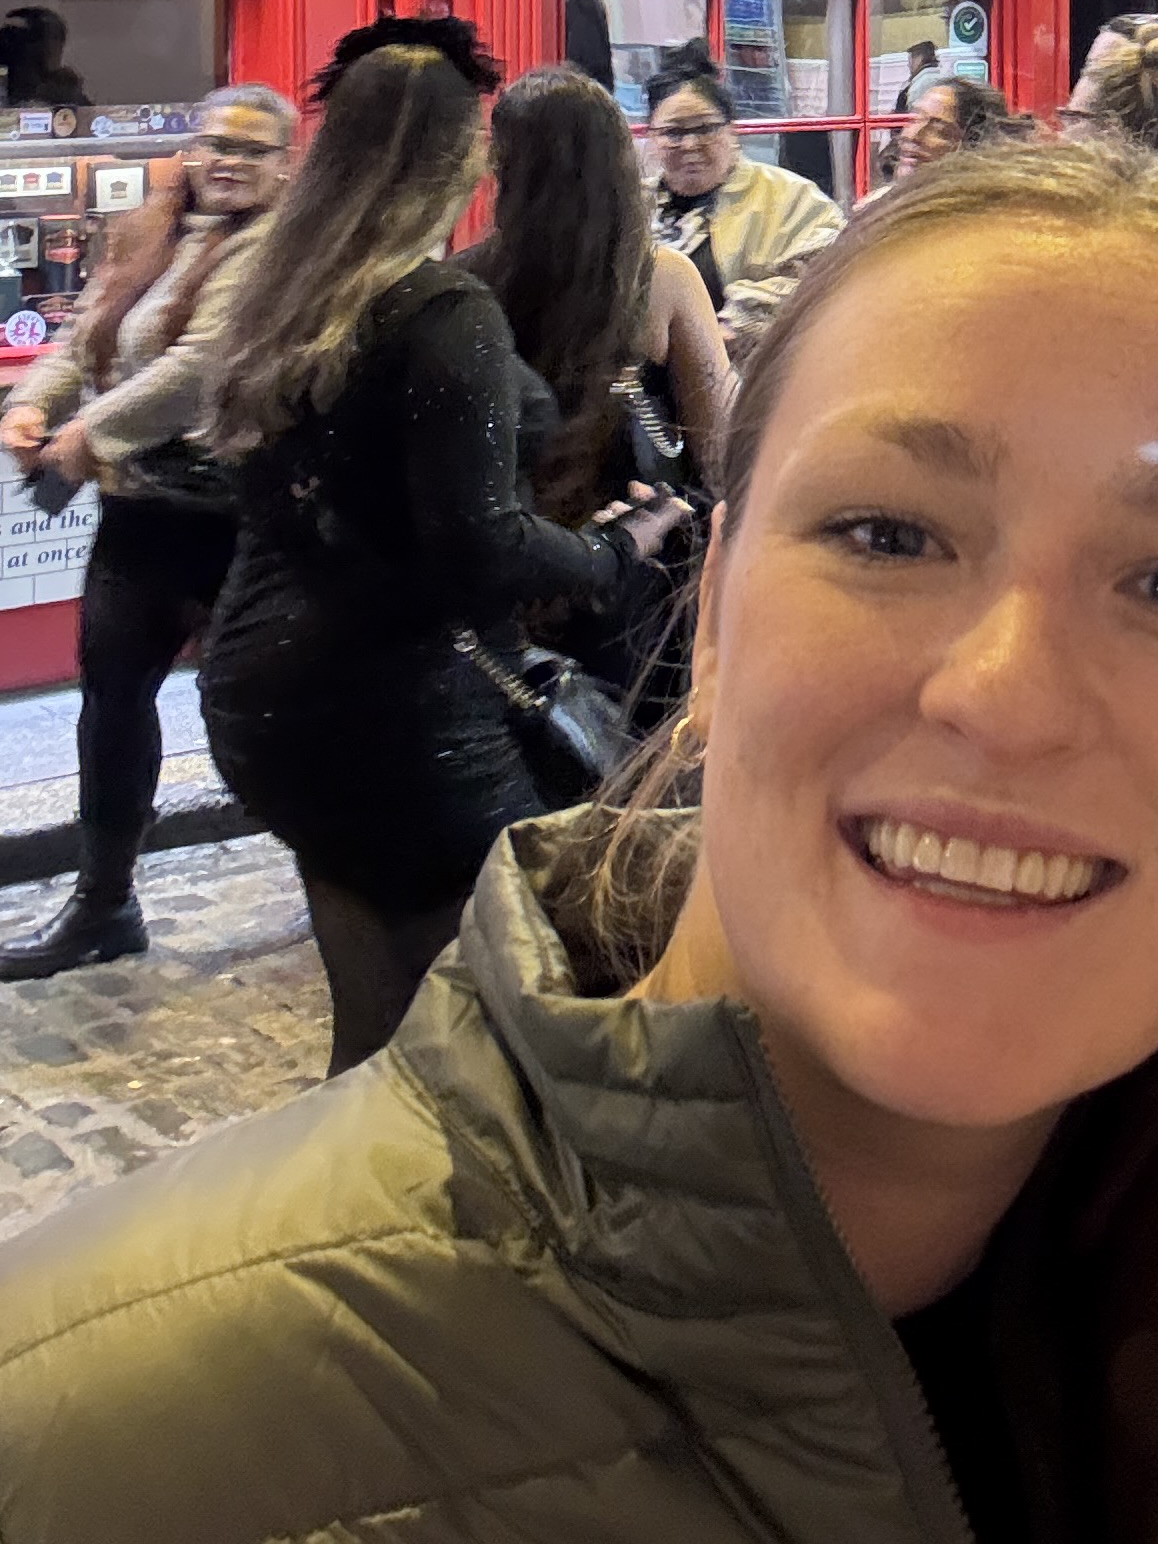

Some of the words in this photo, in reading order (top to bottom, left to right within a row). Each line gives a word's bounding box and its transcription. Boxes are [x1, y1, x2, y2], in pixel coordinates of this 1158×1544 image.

[11, 512, 52, 535] and
[60, 509, 92, 528] the
[7, 551, 29, 569] at
[37, 544, 88, 565] once
